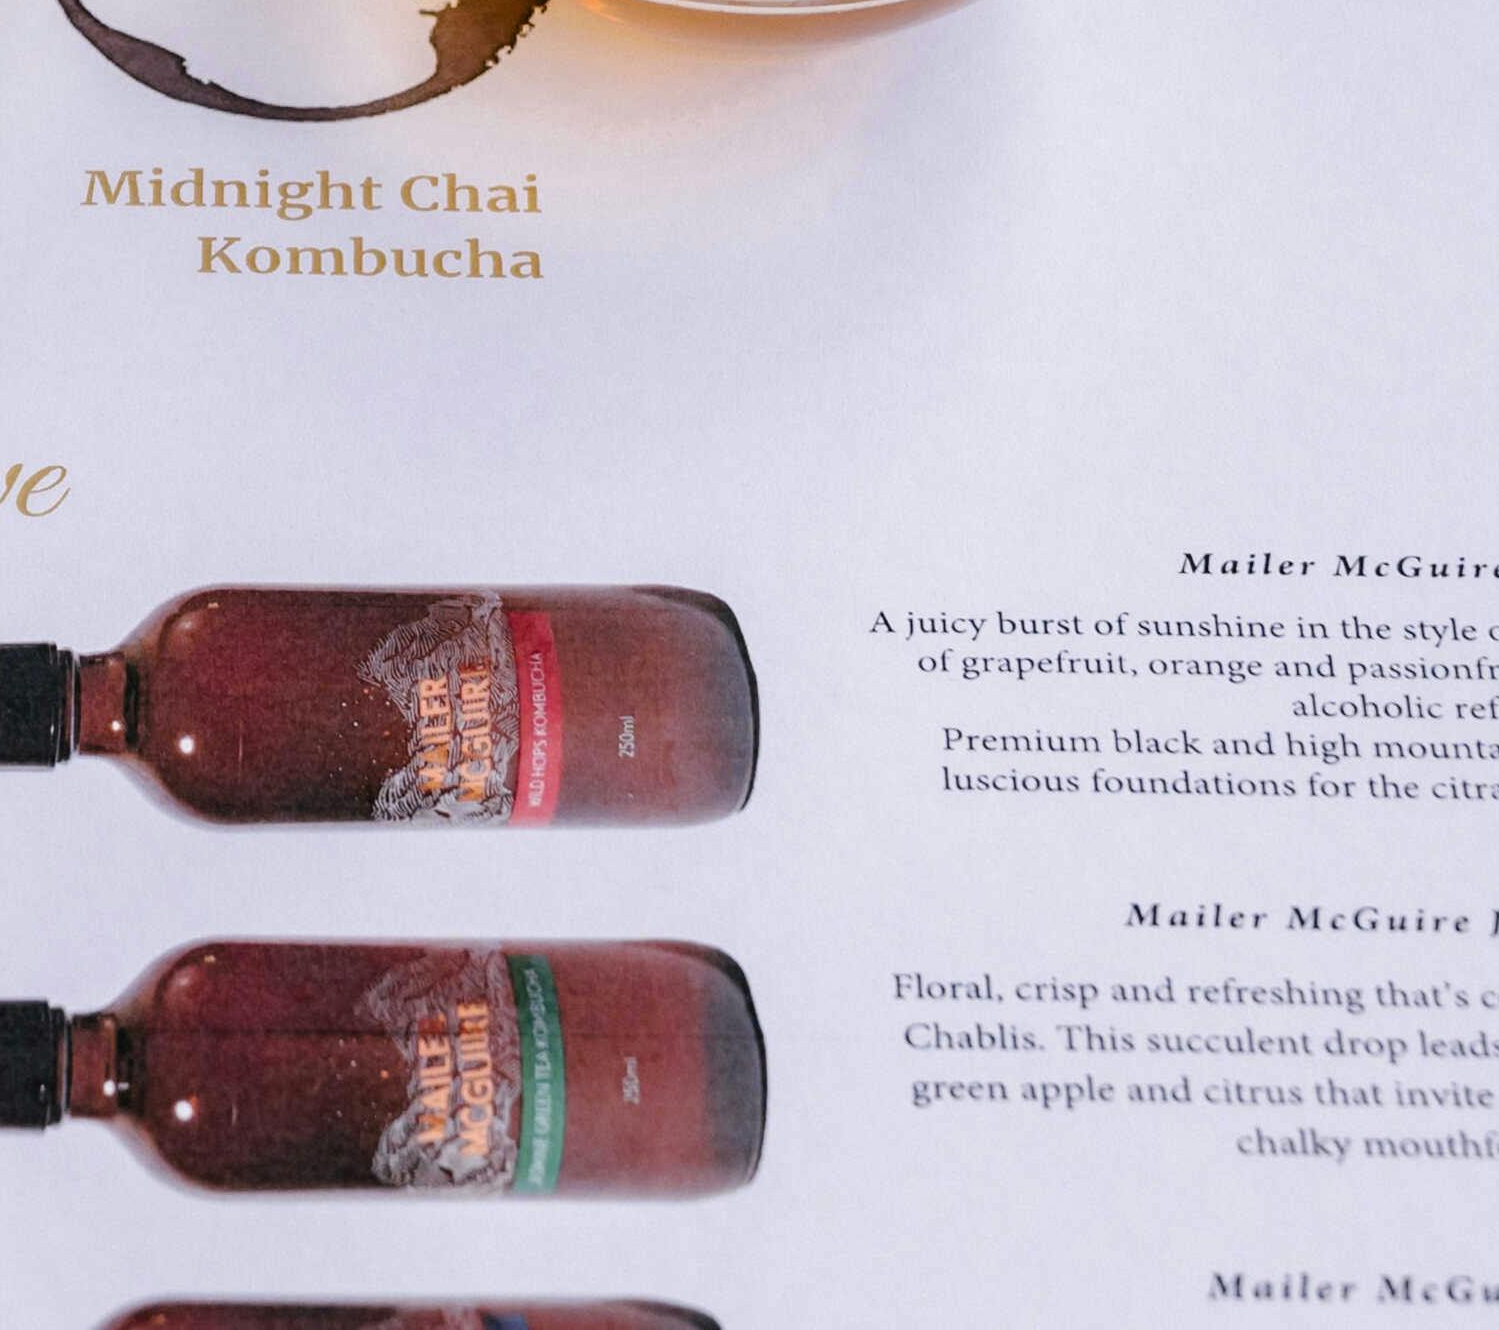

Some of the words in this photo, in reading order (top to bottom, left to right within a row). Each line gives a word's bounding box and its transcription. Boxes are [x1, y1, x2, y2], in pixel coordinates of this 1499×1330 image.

[81, 166, 384, 222] Midnight
[399, 171, 542, 215] Chai
[197, 234, 545, 281] Kombucha
[1177, 550, 1317, 578] Mailer
[868, 609, 897, 635] A
[904, 610, 988, 643] juicy
[995, 609, 1085, 637] burst
[1092, 610, 1131, 638] of
[1136, 611, 1286, 640] sunshine
[1296, 615, 1331, 641] in
[1339, 614, 1393, 642] the
[1402, 615, 1479, 650] style
[916, 645, 950, 674] of
[960, 650, 1139, 682] grapefruit,
[1147, 658, 1264, 686] orange
[1273, 652, 1338, 680] and
[1291, 691, 1443, 721] alcoholic
[941, 726, 1102, 755] Premium
[1110, 727, 1204, 756] black
[1211, 729, 1277, 758] and
[1284, 730, 1363, 767] high
[940, 764, 1081, 794] luscious
[1090, 766, 1298, 798] foundations
[1306, 770, 1358, 800] for
[1366, 771, 1421, 801] the
[1123, 900, 1270, 931] Mailer
[1284, 904, 1472, 936] McGuire
[1206, 1270, 1358, 1304] Mailer
